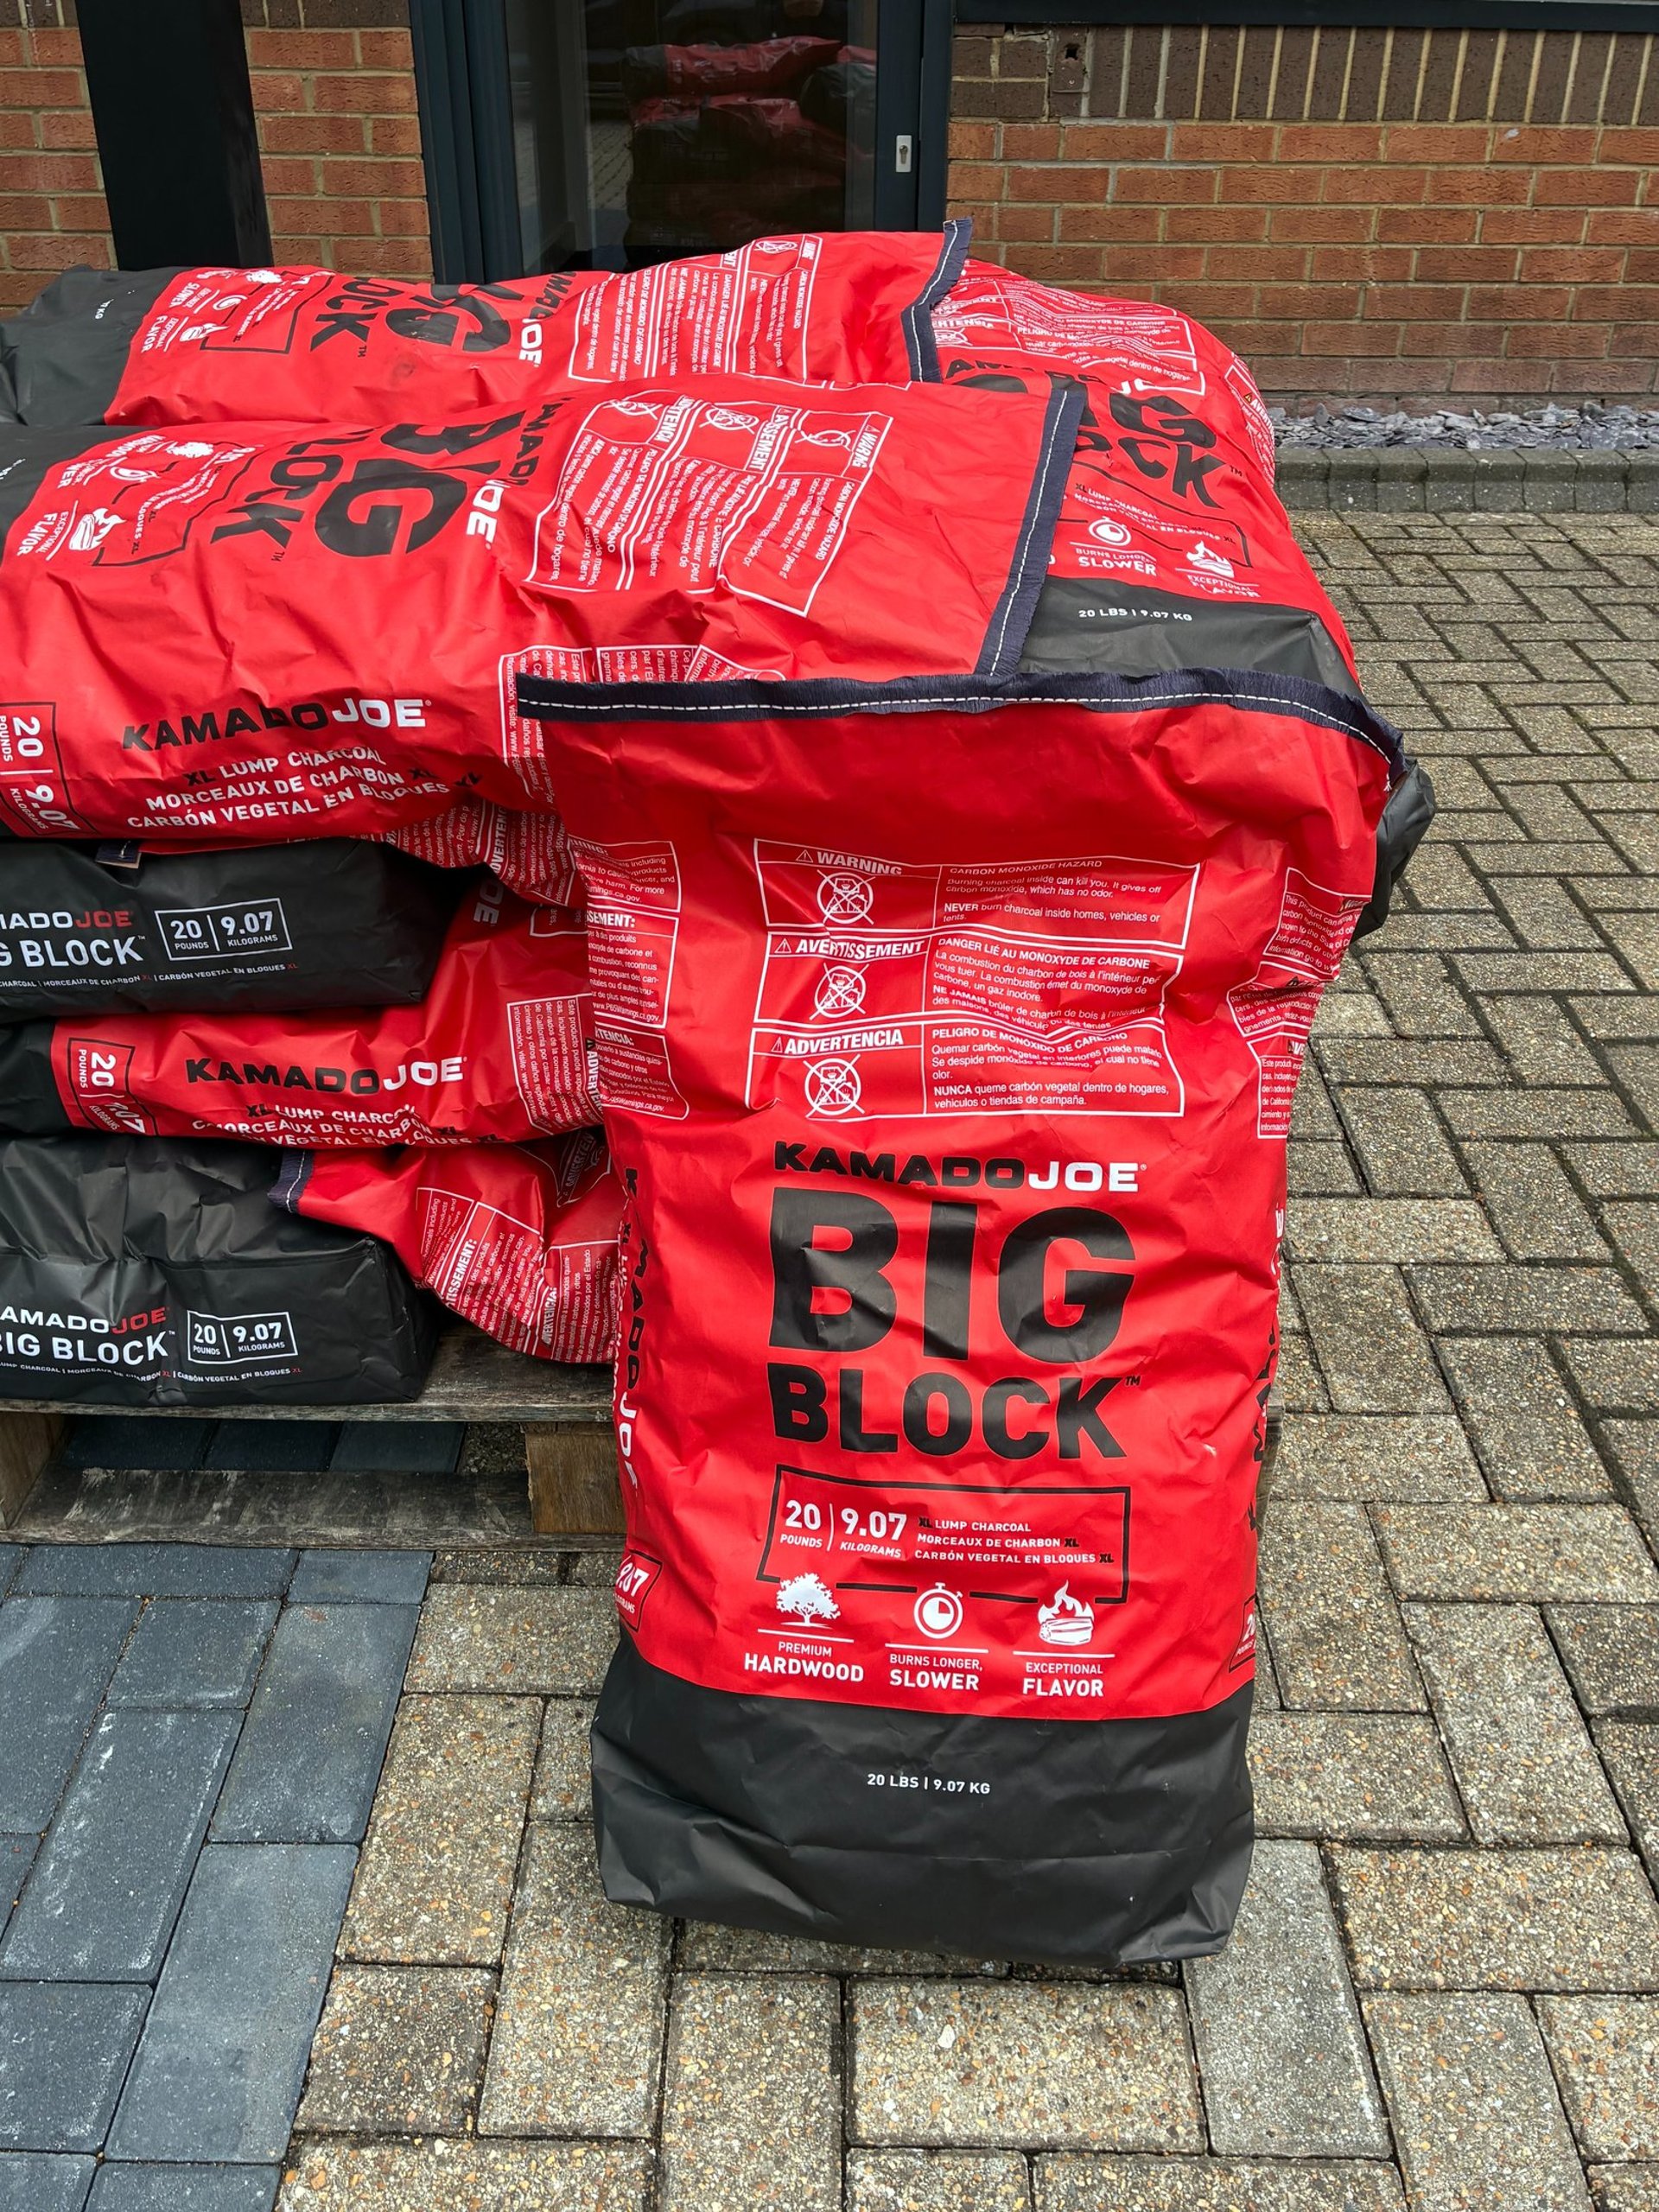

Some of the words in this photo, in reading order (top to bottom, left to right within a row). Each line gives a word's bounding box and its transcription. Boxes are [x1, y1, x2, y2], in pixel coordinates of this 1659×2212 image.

[142, 315, 168, 353] FLAVOR
[17, 512, 51, 556] FLAVOR
[556, 529, 567, 542] de
[549, 544, 564, 581] hogares,
[1075, 548, 1110, 560] BURNS
[1078, 556, 1157, 576] SLOWER
[1078, 609, 1096, 618] 20
[1098, 607, 1128, 618] LBS
[1140, 609, 1169, 620] 9.07
[1173, 612, 1192, 621] KG
[12, 716, 44, 758] 20
[185, 768, 218, 786] XL
[219, 758, 279, 779] LUMP
[288, 747, 386, 766] CHARCOAL
[146, 781, 270, 811] MORCEAUX
[276, 776, 305, 794] DE
[309, 766, 404, 788] CHARBON
[25, 785, 81, 830] 9.07
[127, 809, 217, 830] CARBÓN
[219, 798, 320, 822] VEGETAL
[325, 789, 354, 808] EN
[361, 782, 450, 804] BLOQUES
[817, 851, 902, 875] WARNING
[950, 867, 995, 875] CARBON
[998, 863, 1055, 874] MONOXIDE
[629, 883, 643, 892] For
[645, 886, 664, 895] more
[1030, 886, 1056, 895] which
[1058, 887, 1075, 896] has
[1090, 888, 1114, 898] odor.
[1057, 876, 1074, 885] can
[1121, 884, 1147, 893] gives
[1285, 893, 1298, 906] This
[944, 902, 979, 913] NEVER
[1004, 903, 1043, 917] charcoal
[1045, 907, 1071, 918] inside
[1073, 909, 1107, 922] homes,
[1109, 910, 1147, 923] vehicles
[170, 919, 202, 939] 20
[220, 911, 274, 936] 9.07
[175, 940, 209, 950] POUNDS
[227, 935, 278, 948] KILOGRAMS
[608, 934, 637, 944] produits
[795, 938, 925, 961] AVERTISSEMENT
[19, 937, 143, 968] BLOCK
[615, 947, 643, 957] carbone
[938, 938, 982, 952] DANGER
[984, 941, 1000, 955] LIÉ
[1001, 948, 1017, 957] AU
[1019, 950, 1080, 966] MONOXYDE
[1081, 956, 1096, 966] DE
[1097, 956, 1151, 969] CARBONE
[43, 978, 87, 987] MORCEAUX
[100, 976, 141, 986] CHARBON
[158, 971, 194, 982] CARBÓN
[195, 968, 232, 978] VEGETAL
[246, 963, 286, 974] BLOQUES
[949, 952, 1001, 971] combustion
[1017, 965, 1055, 979] charbon
[1097, 969, 1141, 984] l'intérieur
[933, 970, 972, 990] carbone,
[1007, 987, 1043, 1002] inodore.
[934, 962, 957, 973] vous
[994, 972, 1046, 991] combustion
[1084, 982, 1133, 996] monoxyde
[556, 1000, 565, 1015] cas,
[568, 999, 576, 1015] Este
[932, 984, 948, 994] NE
[950, 989, 987, 1005] JAMAIS
[988, 998, 1015, 1014] brûler
[524, 1005, 533, 1034] cimiento
[557, 1017, 569, 1054] incluyendo
[569, 1017, 579, 1047] producto
[784, 1028, 904, 1055] ADVERTENCIA
[932, 1028, 980, 1039] PELIGRO
[982, 1029, 997, 1039] DE
[999, 1032, 1055, 1053] MONÓXIDO
[1057, 1043, 1073, 1053] DE
[518, 1051, 527, 1071] visite:
[572, 1050, 582, 1071] puede
[931, 1044, 969, 1056] Quemar
[972, 1043, 1006, 1053] carbón
[1056, 1049, 1102, 1062] interiores
[1103, 1045, 1133, 1057] puede
[932, 1056, 945, 1068] Se
[948, 1053, 985, 1068] despide
[987, 1053, 1033, 1066] monóxido
[1105, 1055, 1125, 1065] cual
[78, 1048, 87, 1090] POUNDS
[91, 1052, 117, 1089] 20
[932, 1069, 953, 1080] olor.
[933, 1084, 973, 1096] NUNCA
[975, 1084, 1007, 1096] queme
[1008, 1080, 1042, 1093] carbón
[1044, 1082, 1080, 1095] vegetal
[1083, 1082, 1113, 1094] dentro
[1115, 1082, 1127, 1093] de
[1128, 1082, 1170, 1096] hogares,
[989, 1095, 1023, 1106] tiendas
[1025, 1093, 1038, 1104] de
[1039, 1093, 1087, 1108] campaña.
[246, 1104, 271, 1119] XL
[275, 1105, 324, 1122] LUMP
[320, 1123, 344, 1135] DE
[774, 1140, 1140, 1192] KAMADOJOE
[767, 1186, 1136, 1364] BIG
[194, 1323, 217, 1345] 20
[232, 1322, 283, 1342] 9.07
[52, 1332, 168, 1365] BLOCK
[193, 1345, 221, 1356] POUNDS
[238, 1341, 285, 1353] KILOGRAMS
[20, 1364, 60, 1373] CHARCOAL
[177, 1371, 204, 1382] CARBÓN
[254, 1368, 291, 1378] BLOQUES
[766, 1362, 1128, 1460] BLOCK
[784, 1499, 822, 1531] 20
[840, 1507, 908, 1542] 9.07
[935, 1519, 968, 1532] LUMP
[971, 1522, 1032, 1533] CHARCOAL
[779, 1534, 823, 1548] POUNDS
[839, 1541, 902, 1559] KILOGRAMS
[917, 1534, 982, 1548] MORCEAUX
[986, 1537, 1001, 1548] DE
[1004, 1537, 1061, 1548] CHARBON
[914, 1548, 964, 1561] CARBÓN
[968, 1553, 1021, 1564] VEGETAL
[1025, 1554, 1041, 1564] EN
[1044, 1553, 1096, 1565] BLOQUES
[778, 1641, 832, 1657] PREMIUM
[744, 1652, 865, 1683] HARDWOOD
[889, 1653, 931, 1668] BURNS
[932, 1656, 983, 1672] LONGER,
[1025, 1661, 1104, 1675] EXCEPTIONAL
[889, 1669, 980, 1692] SLOWER
[1022, 1677, 1105, 1698] FLAVOR
[867, 1773, 885, 1786] 20
[889, 1774, 920, 1789] LBS
[933, 1778, 965, 1793] 9.07
[969, 1781, 991, 1795] KG
